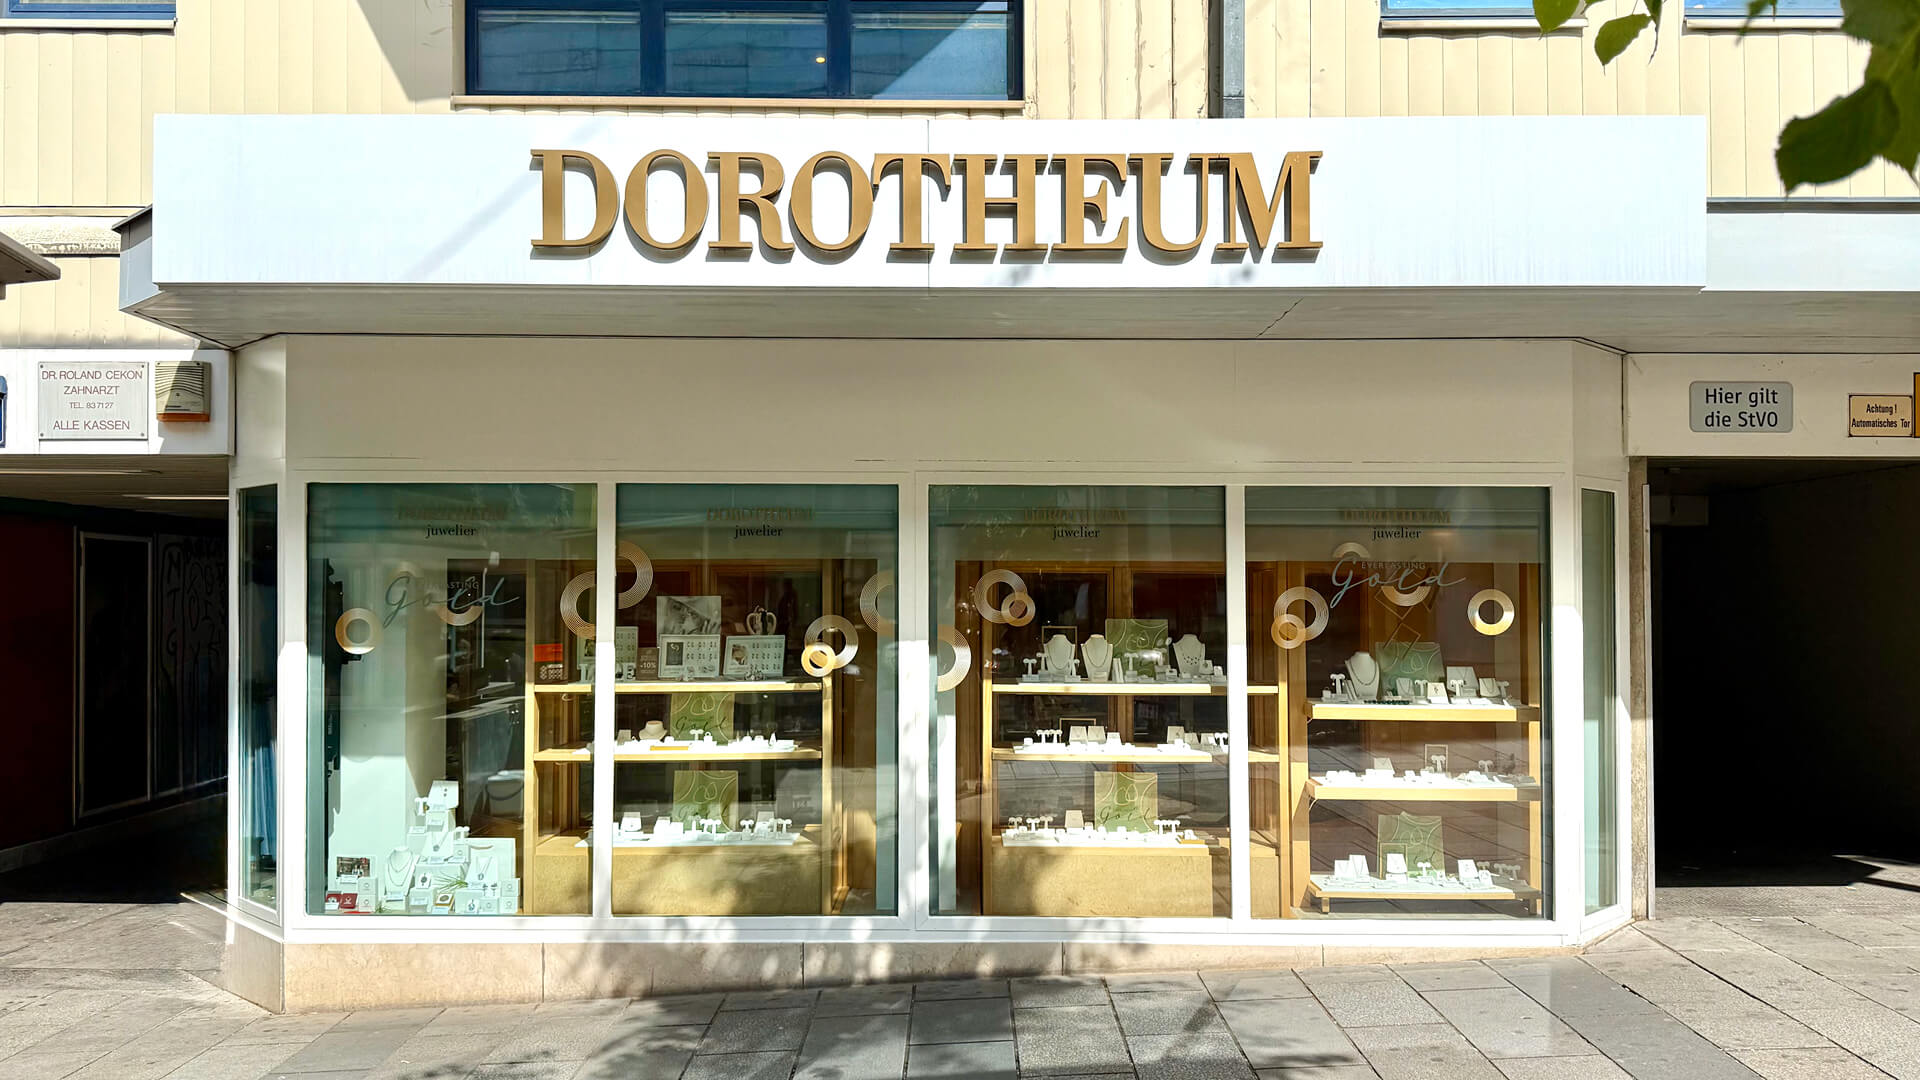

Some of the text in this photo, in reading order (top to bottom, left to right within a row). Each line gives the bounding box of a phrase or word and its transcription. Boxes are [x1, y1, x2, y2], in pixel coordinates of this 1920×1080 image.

[531, 149, 1323, 253] DOROTHEUM
[59, 370, 102, 380] ROLAND
[105, 370, 143, 380] CEKON
[63, 385, 121, 395] ZAHNARZT
[1705, 387, 1779, 408] Hier gilt
[53, 420, 130, 430] ALLE KASSEN
[1704, 411, 1778, 428] die StVO
[1851, 417, 1911, 428] Automatisches Tor
[425, 524, 477, 539] juwelier
[734, 525, 784, 540] juwelier
[1052, 526, 1100, 541] juwelier
[1372, 527, 1422, 542] juwelier
[1329, 554, 1467, 609] Gold
